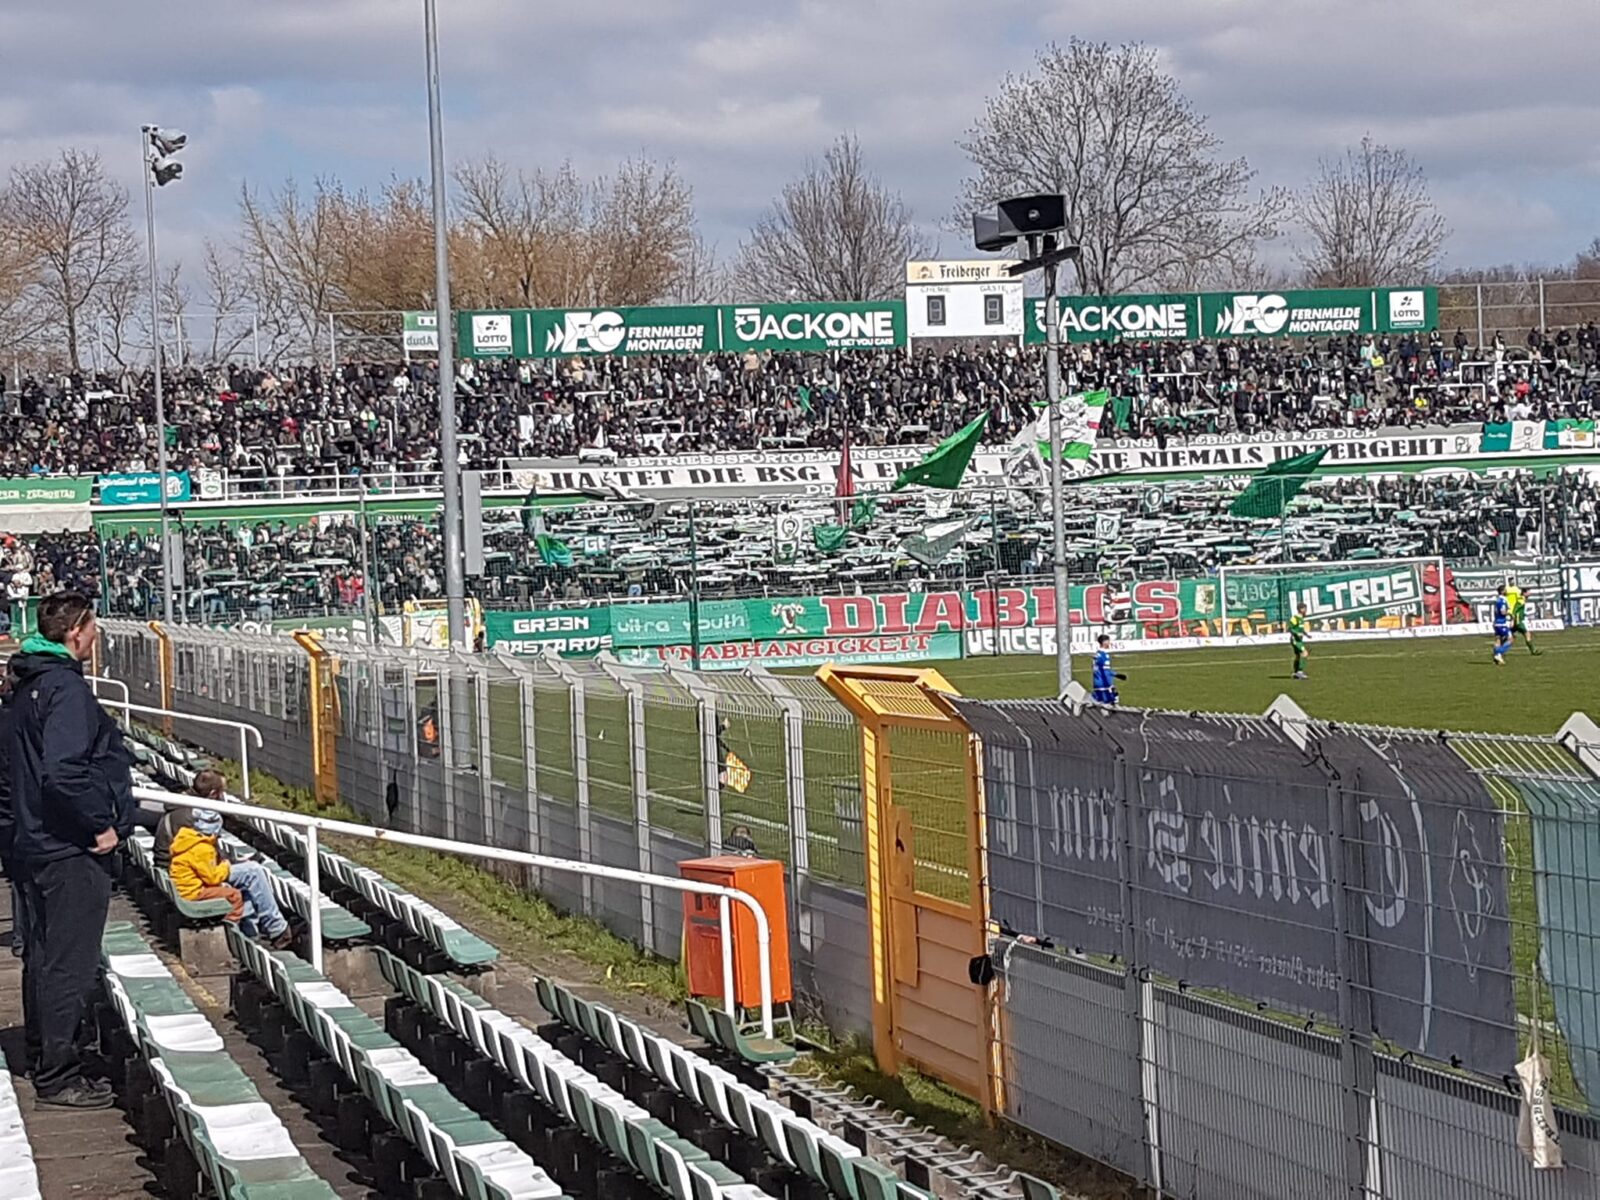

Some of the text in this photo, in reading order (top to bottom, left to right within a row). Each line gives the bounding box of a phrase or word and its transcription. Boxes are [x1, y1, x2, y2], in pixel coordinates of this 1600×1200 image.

[939, 265, 990, 280] Freiberger
[1291, 306, 1361, 320] FERNMELDE
[628, 325, 704, 338] FERNMELDE
[735, 308, 894, 341] JACKONE
[1288, 319, 1360, 332] MONTAGEN
[477, 335, 507, 343] LOTTO
[625, 338, 703, 351] MONTAGEN
[687, 467, 746, 483] DIE
[756, 465, 820, 483] BSG
[1140, 446, 1262, 467] NIEMALS
[1288, 571, 1415, 616] ULTRAS
